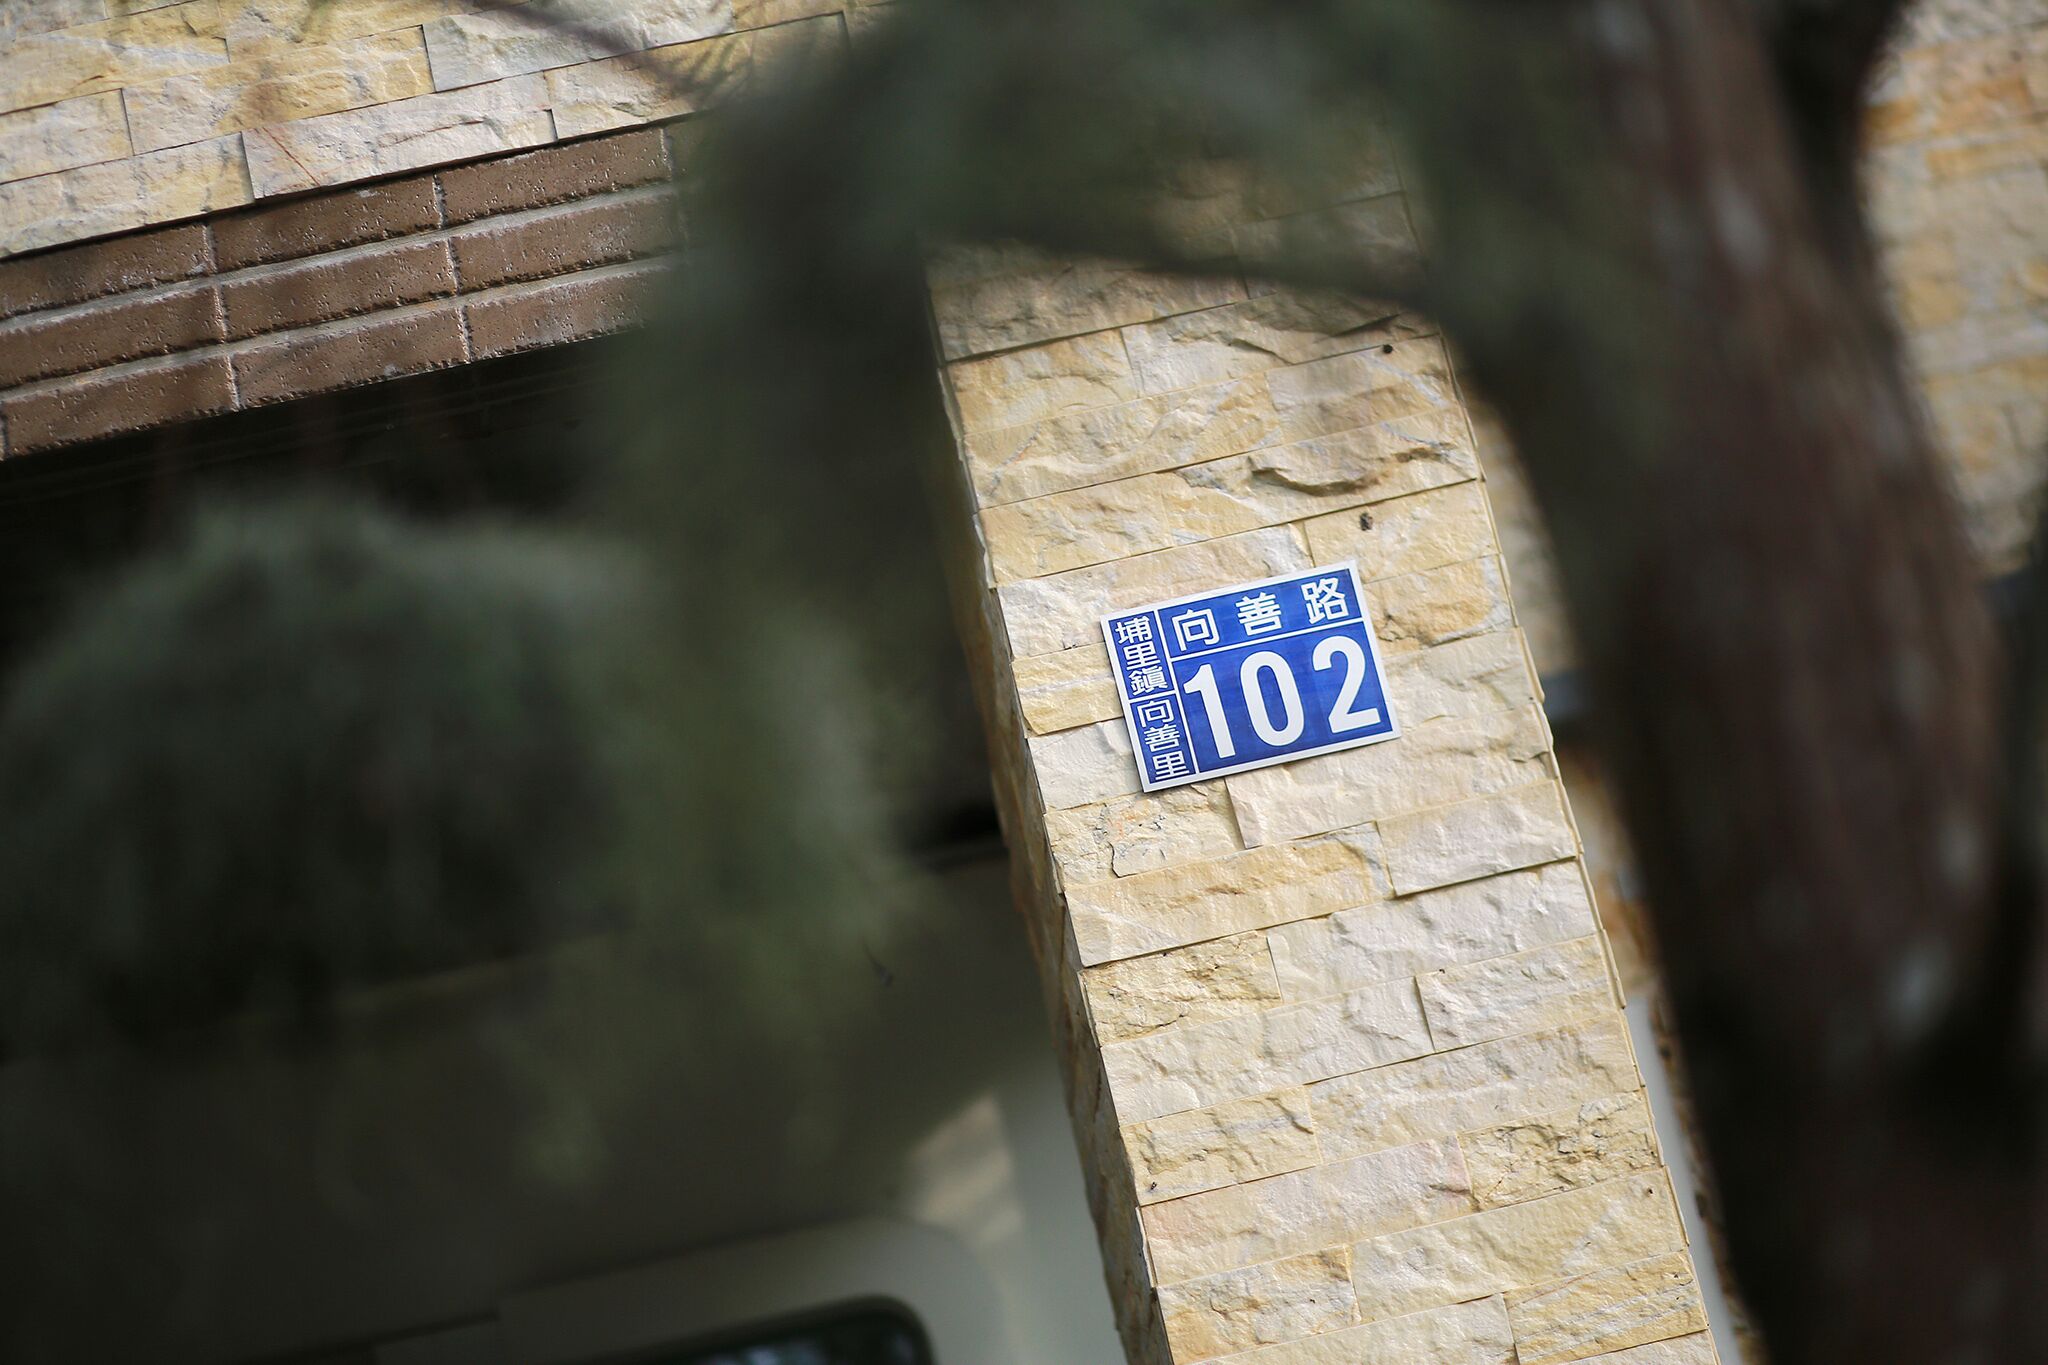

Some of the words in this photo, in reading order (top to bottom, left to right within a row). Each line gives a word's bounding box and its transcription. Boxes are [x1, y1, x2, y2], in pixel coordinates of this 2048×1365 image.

[1172, 577, 1349, 651] 向善路
[1183, 635, 1381, 759] 102
[1136, 699, 1190, 780] 向善里
